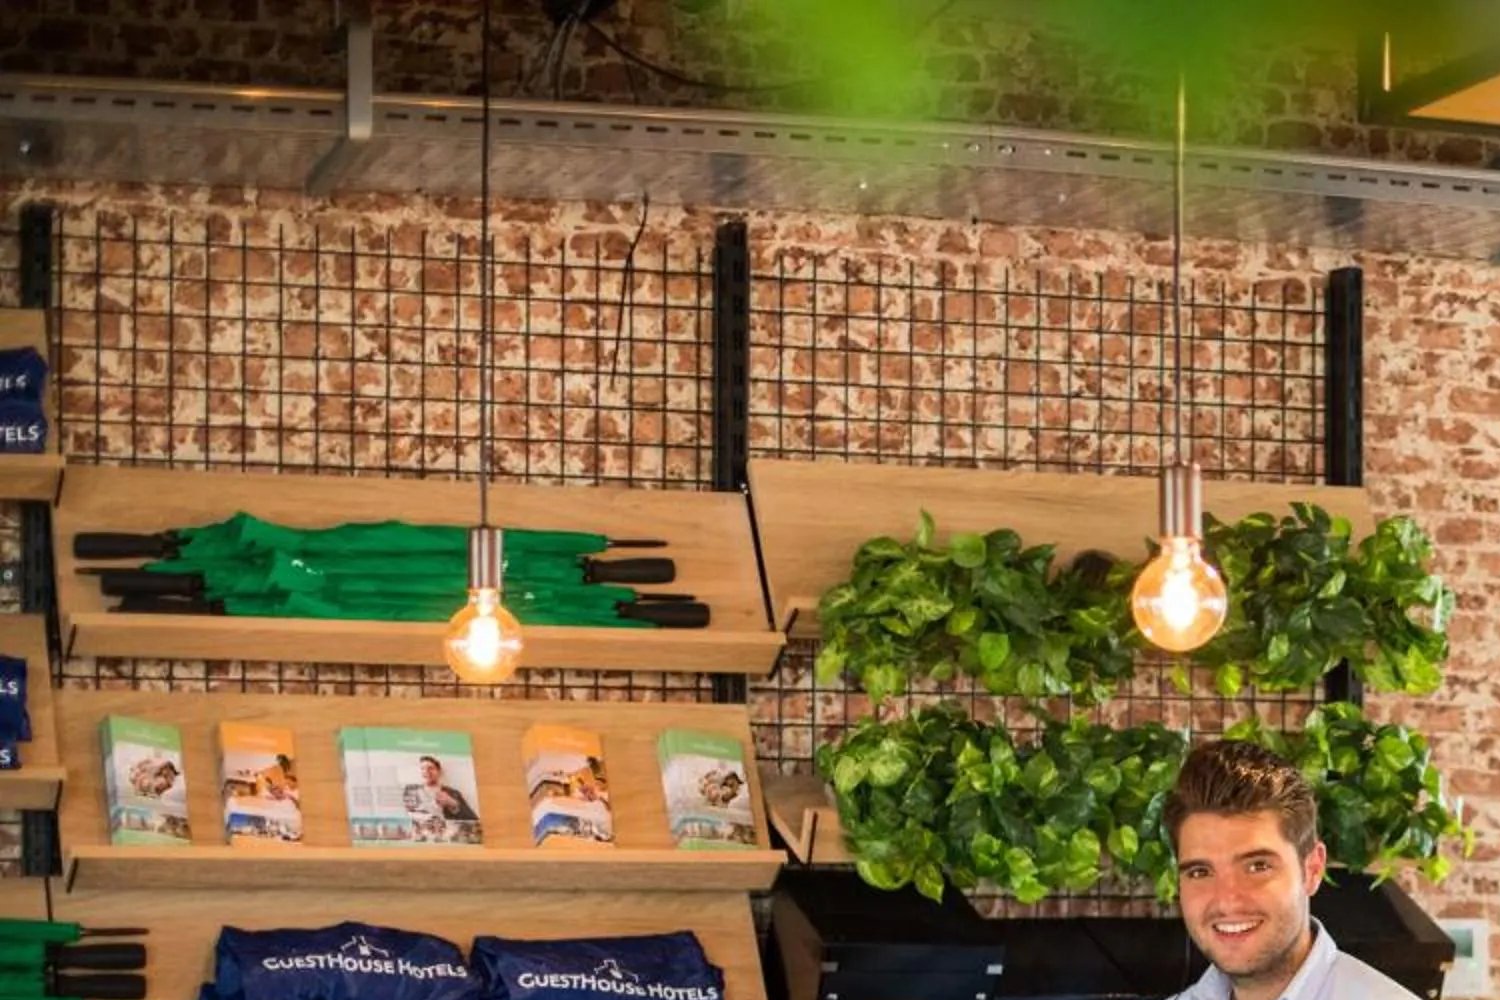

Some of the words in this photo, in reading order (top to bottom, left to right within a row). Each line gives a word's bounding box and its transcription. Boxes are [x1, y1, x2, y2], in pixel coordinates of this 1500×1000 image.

[262, 953, 395, 975] GUESTHOUSE
[399, 957, 468, 979] HOTELS
[517, 972, 646, 996] GUESTHOUSE
[647, 982, 719, 1000] HOTELS
